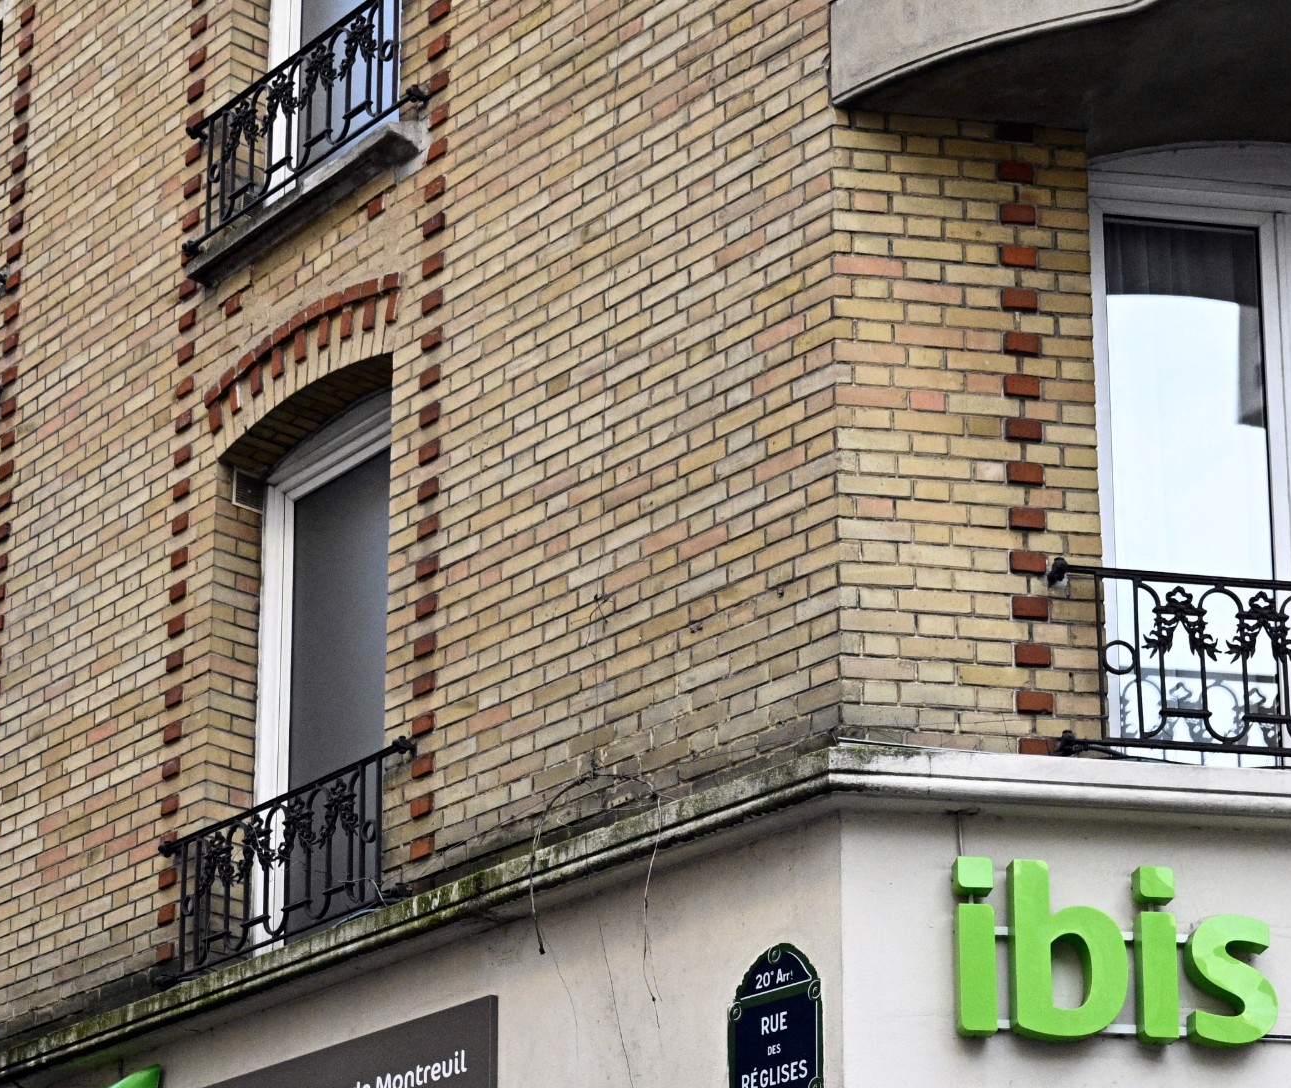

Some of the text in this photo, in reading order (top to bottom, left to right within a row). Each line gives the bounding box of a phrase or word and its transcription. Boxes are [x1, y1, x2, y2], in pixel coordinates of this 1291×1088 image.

[950, 855, 1278, 1049] ibis
[761, 1010, 788, 1036] RUE
[767, 1043, 782, 1056] DES
